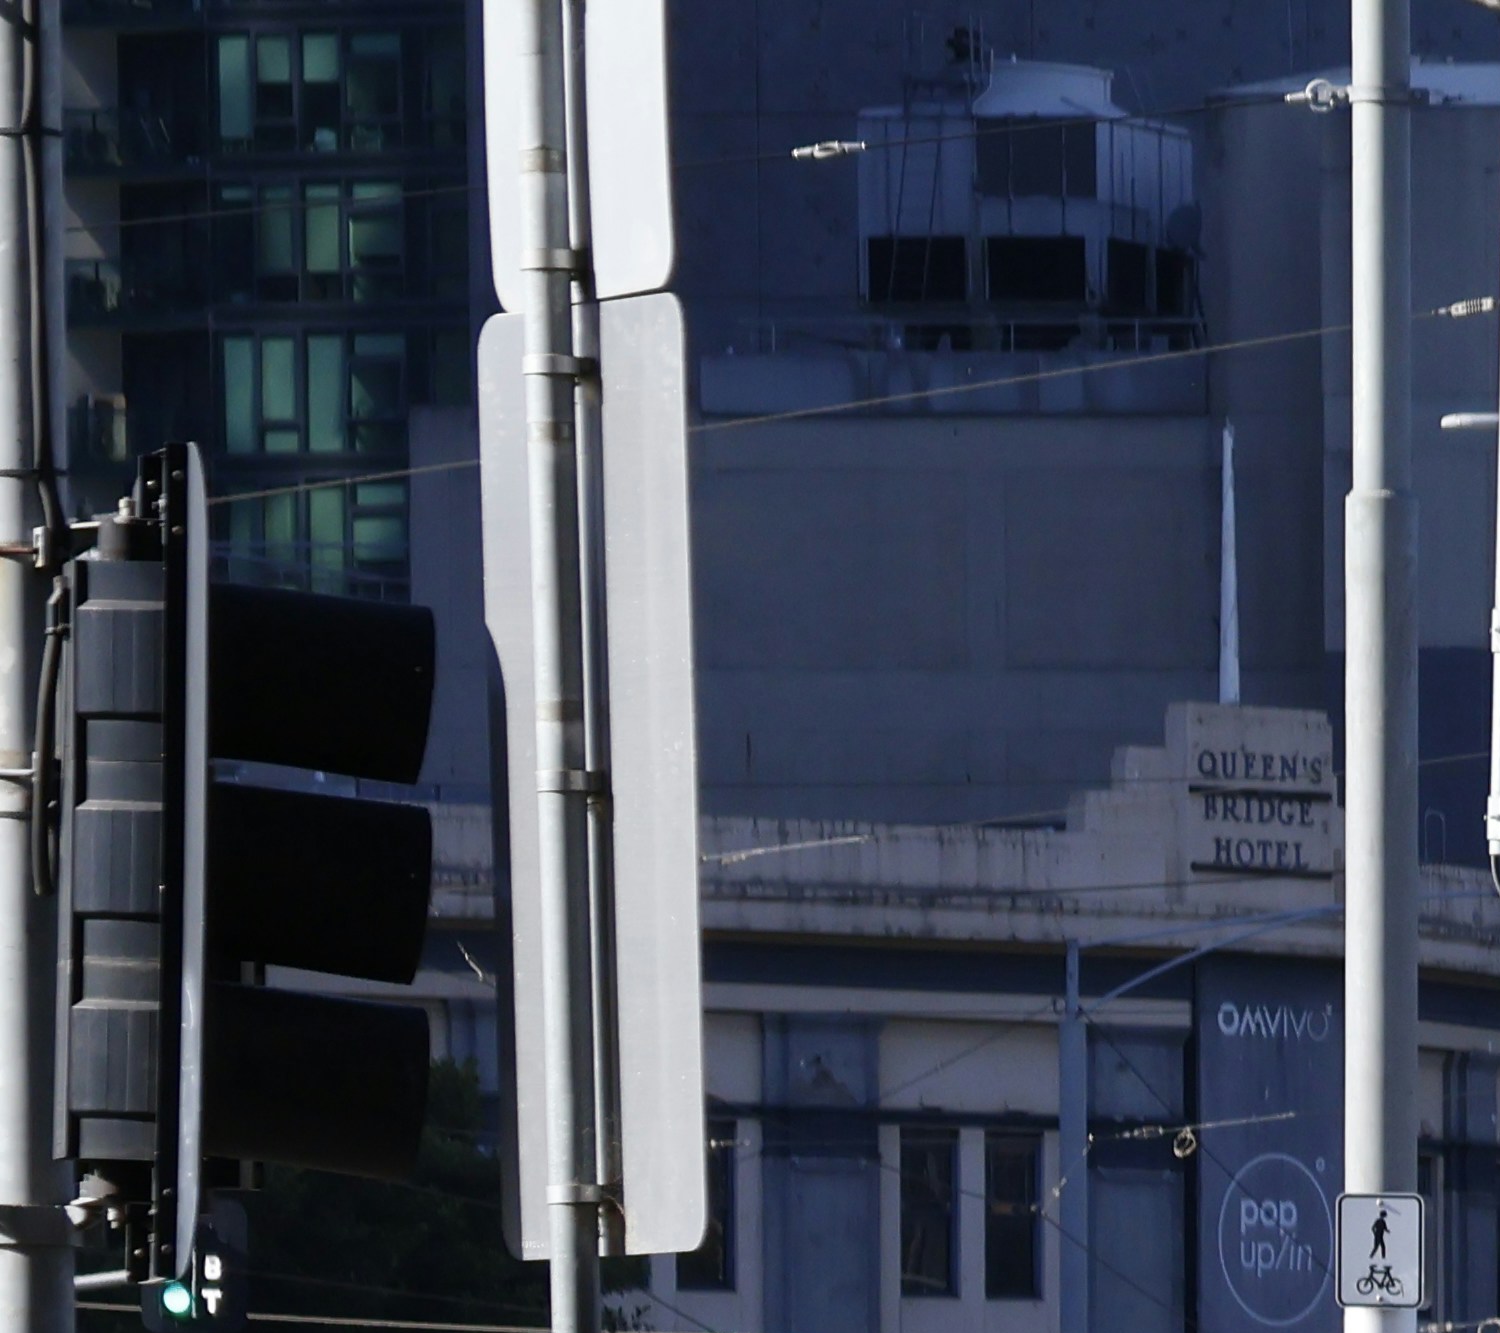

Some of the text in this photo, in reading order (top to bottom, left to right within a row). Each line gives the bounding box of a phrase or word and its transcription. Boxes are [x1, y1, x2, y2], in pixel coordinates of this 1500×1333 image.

[1198, 750, 1323, 784] QUEEN'S
[1204, 794, 1314, 825] BRIDGE
[1214, 837, 1308, 872] HOTEL
[1241, 1199, 1297, 1238] pop
[1241, 1234, 1312, 1277] up/in
